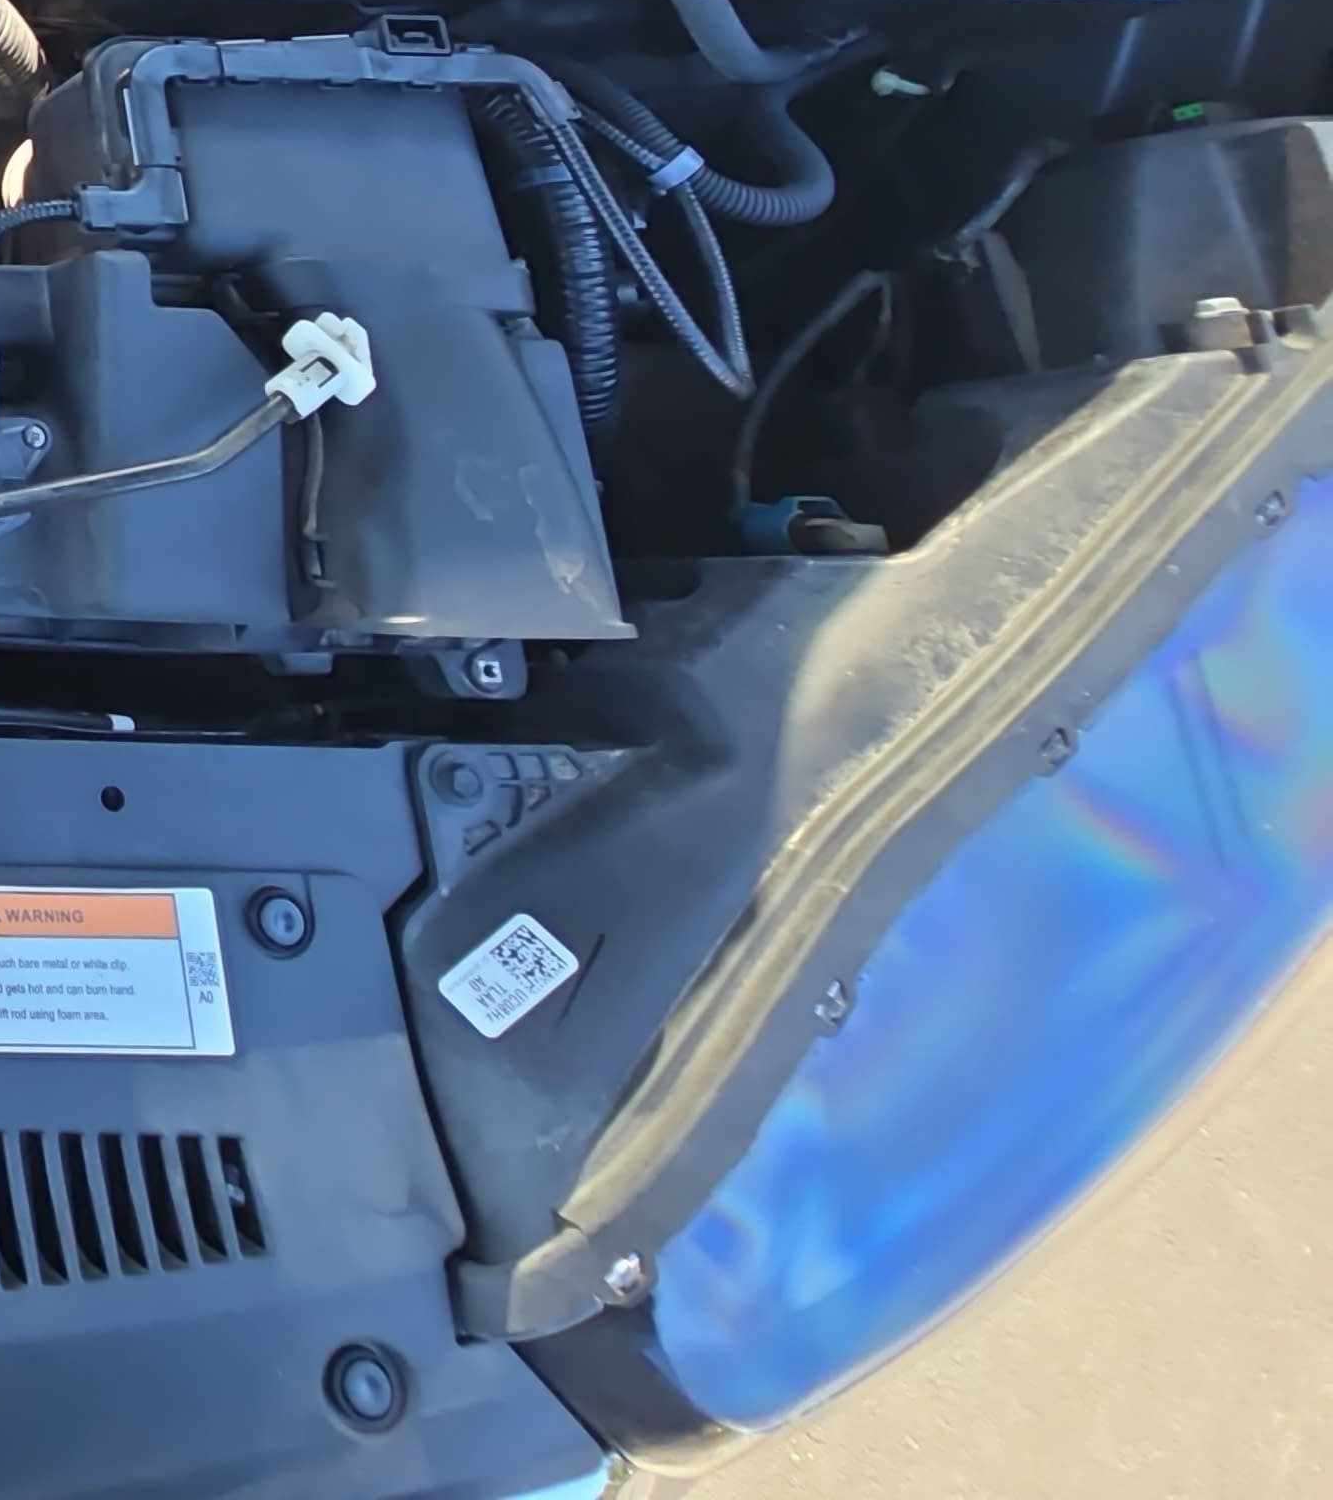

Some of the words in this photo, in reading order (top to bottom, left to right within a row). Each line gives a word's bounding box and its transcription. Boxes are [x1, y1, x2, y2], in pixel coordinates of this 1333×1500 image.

[5, 909, 84, 923] WARNING
[19, 958, 39, 969] bare
[42, 958, 68, 969] metal
[71, 960, 80, 969] or
[83, 958, 108, 970] white
[110, 959, 130, 972] clip.
[6, 984, 26, 996] gets
[28, 983, 43, 994] hot
[46, 984, 63, 994] and
[66, 985, 83, 995] can
[86, 984, 107, 995] burn
[475, 981, 508, 1008] TLAA
[11, 1008, 26, 1020] rod
[30, 1009, 55, 1022] using
[57, 1009, 80, 1020] foam
[84, 1010, 109, 1021] area.
